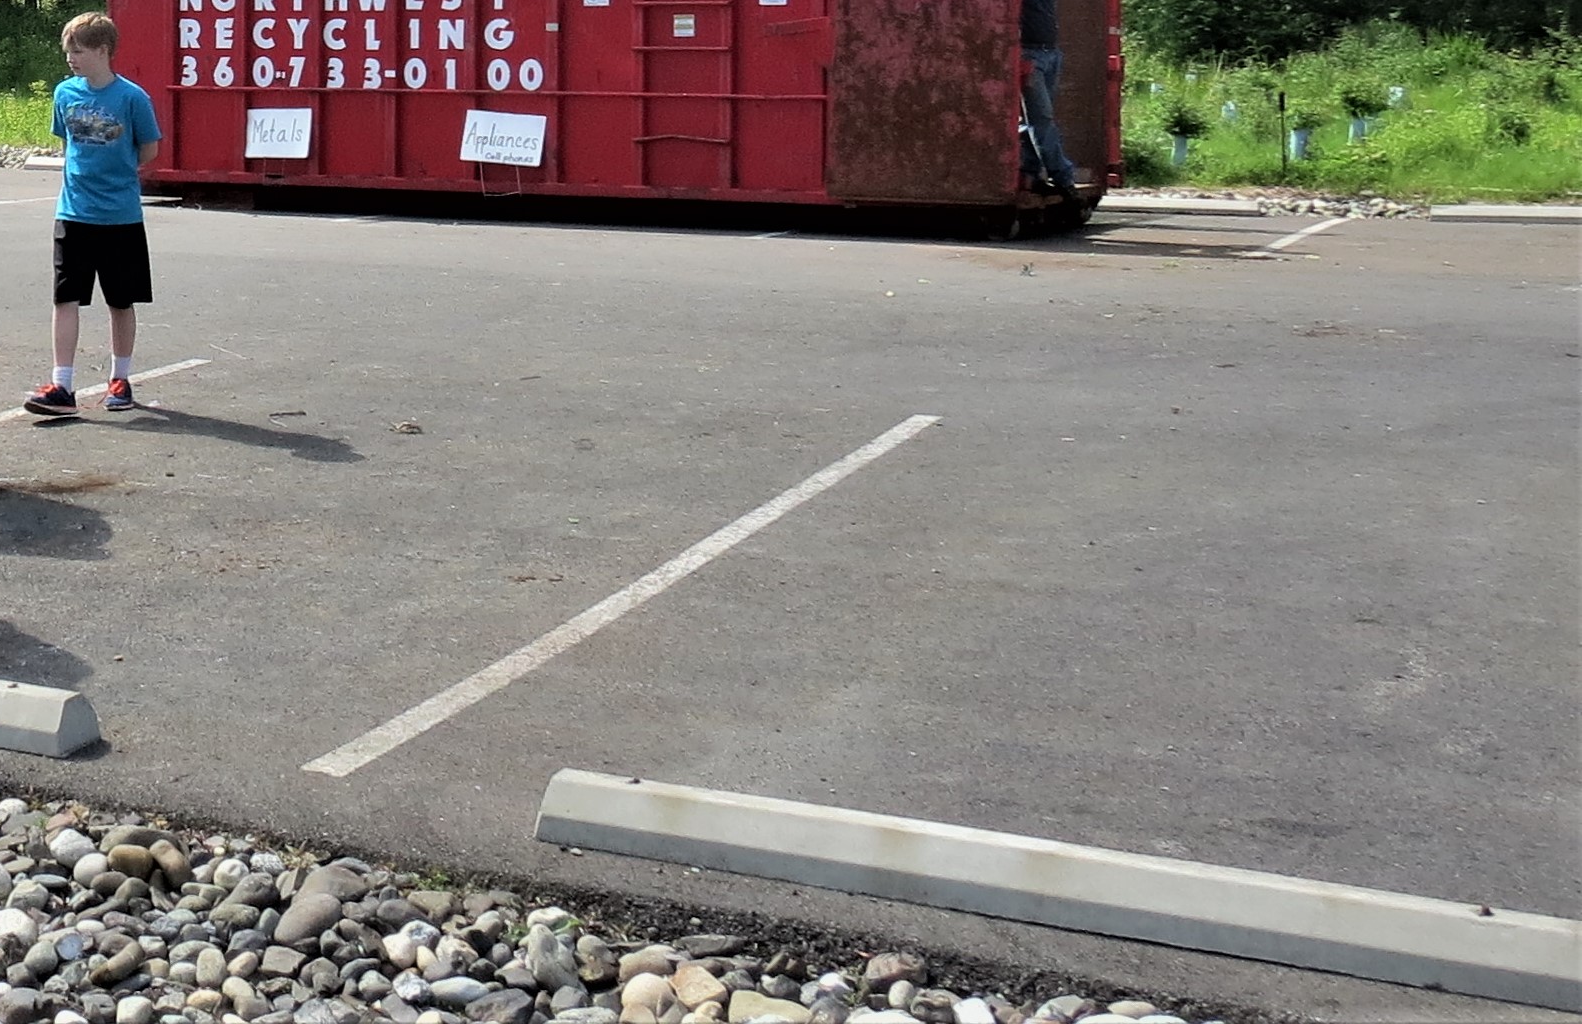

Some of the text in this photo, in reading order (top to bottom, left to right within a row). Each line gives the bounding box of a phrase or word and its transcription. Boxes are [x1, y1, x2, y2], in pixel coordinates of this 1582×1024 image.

[179, 18, 515, 51] RECYCLING
[251, 118, 304, 144] Metals
[464, 121, 540, 155] Appliances
